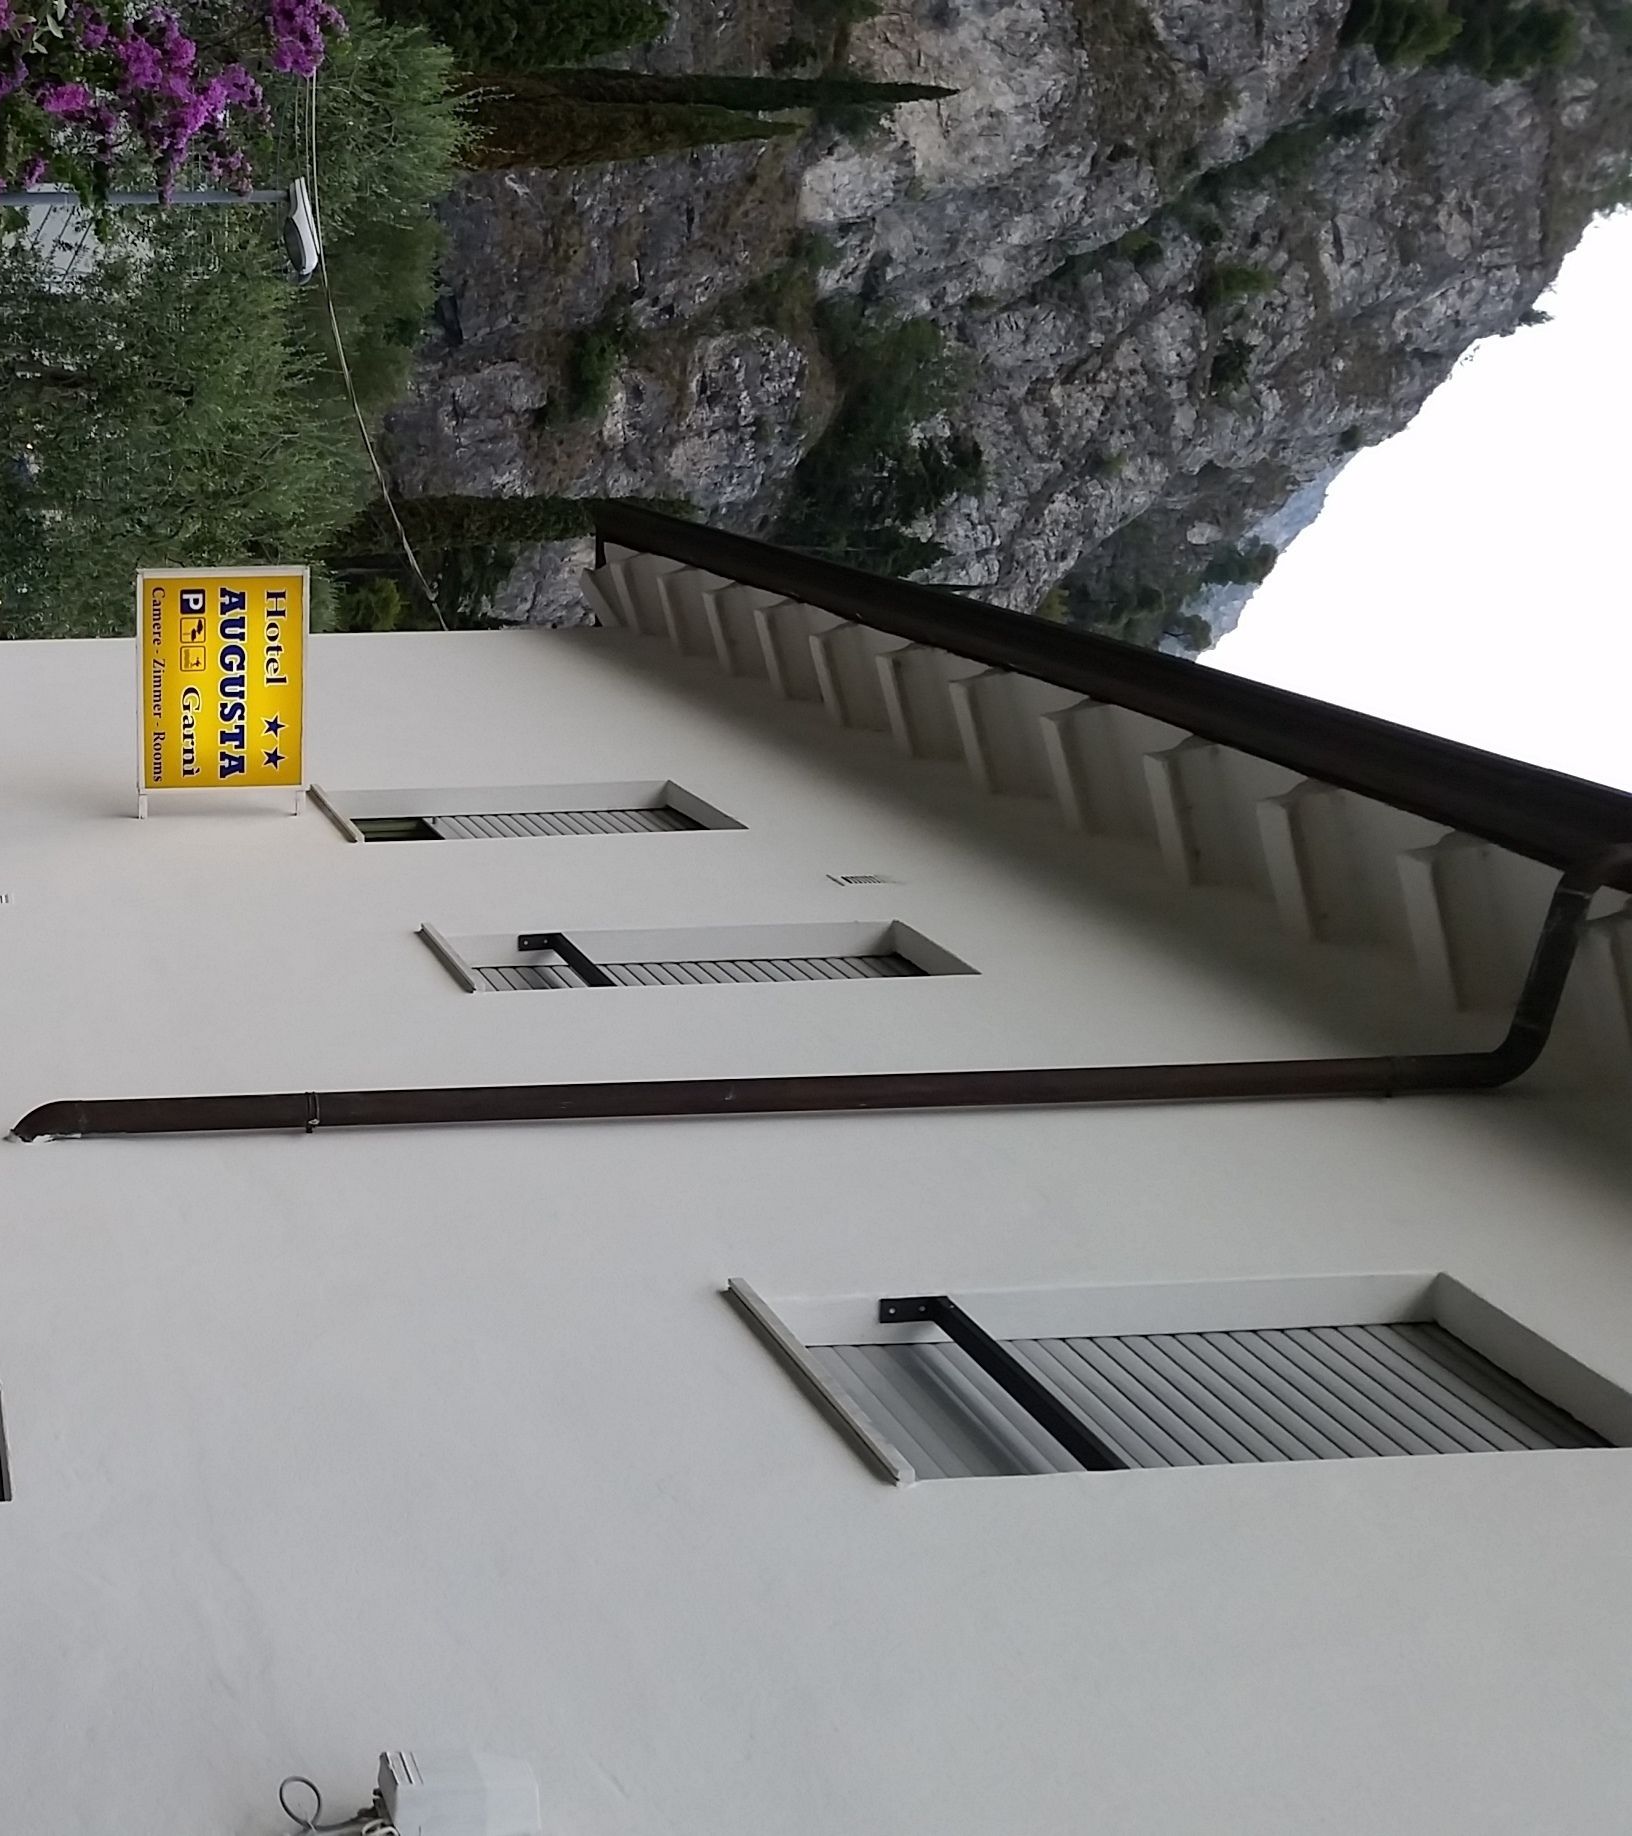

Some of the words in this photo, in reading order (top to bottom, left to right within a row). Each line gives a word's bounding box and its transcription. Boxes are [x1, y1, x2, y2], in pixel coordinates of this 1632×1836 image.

[152, 587, 165, 645] Camere
[265, 590, 287, 685] Hotel
[152, 659, 165, 718] Zimmer
[219, 587, 246, 779] AUGUSTA
[152, 732, 165, 782] Rooms
[182, 687, 201, 777] Garnì
